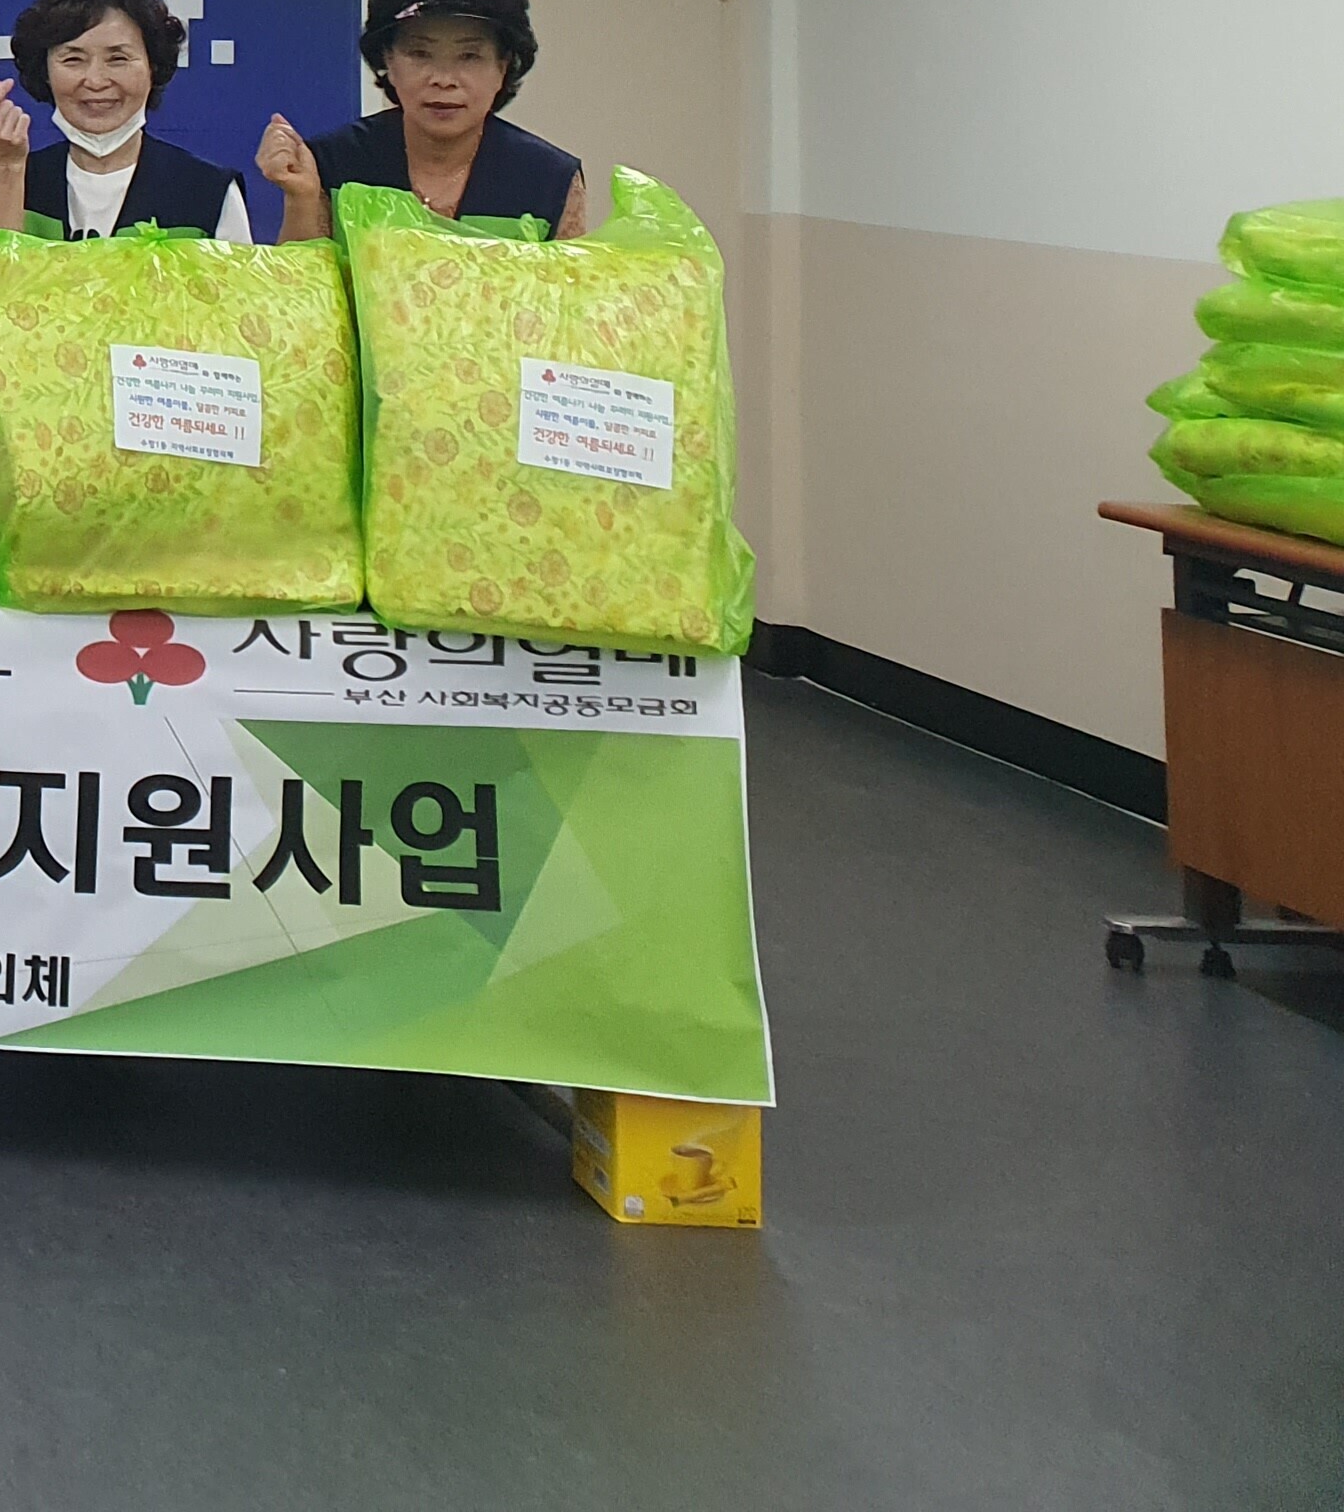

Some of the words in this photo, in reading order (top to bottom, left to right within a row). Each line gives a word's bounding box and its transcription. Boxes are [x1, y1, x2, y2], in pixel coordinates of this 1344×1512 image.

[129, 412, 164, 428] 건강한
[534, 427, 569, 445] 건강한
[344, 689, 406, 706] 부산
[419, 691, 697, 717] 사회복지공동모금회
